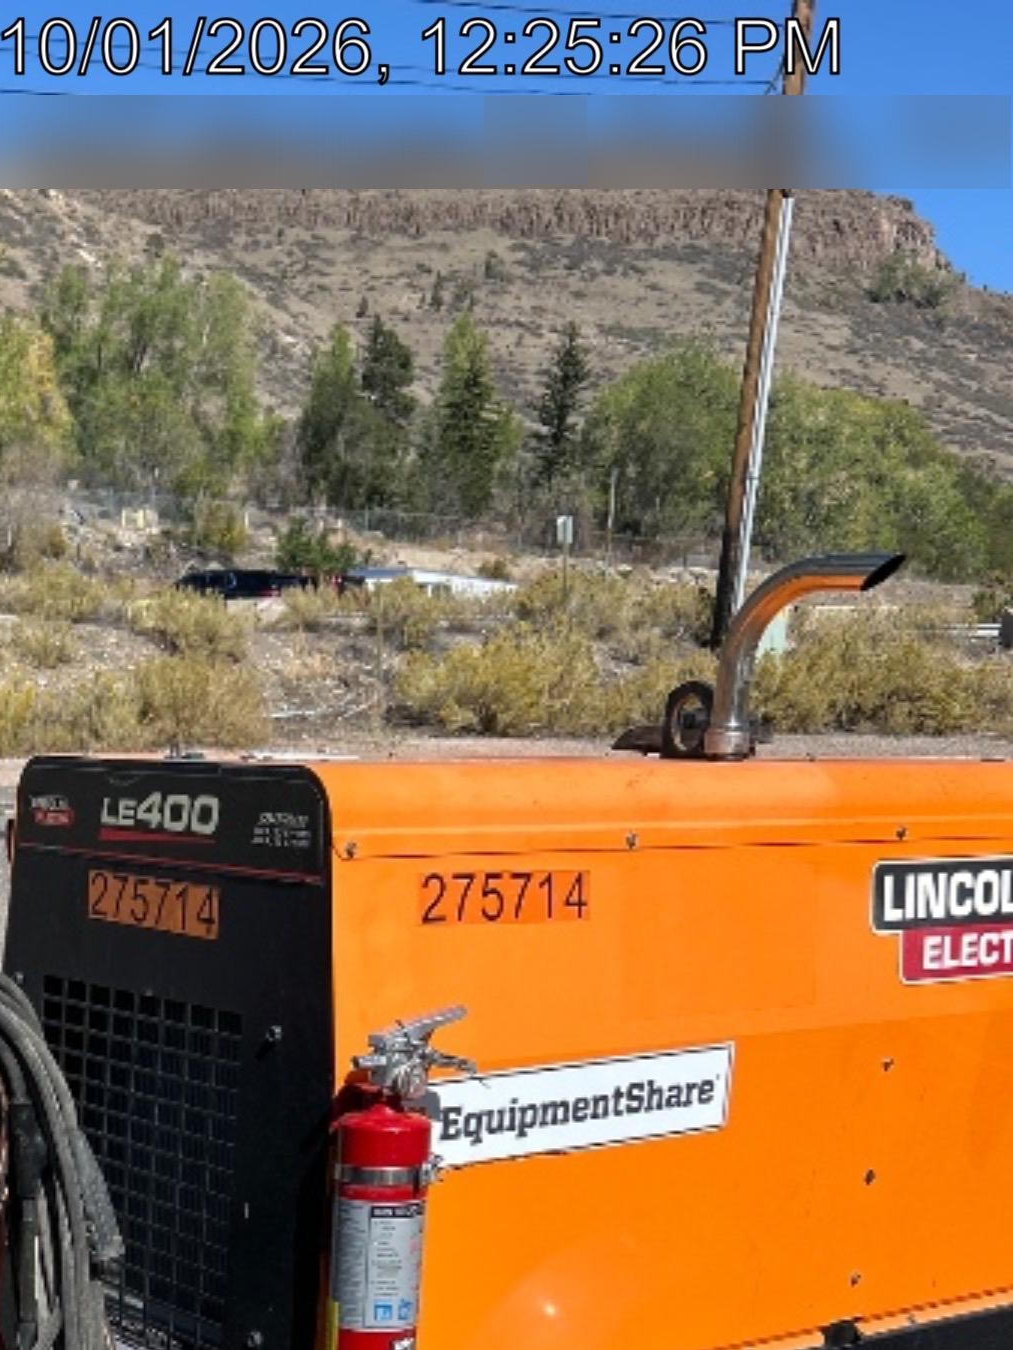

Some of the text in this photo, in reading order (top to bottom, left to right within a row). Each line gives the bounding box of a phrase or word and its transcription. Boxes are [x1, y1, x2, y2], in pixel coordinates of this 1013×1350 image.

[99, 791, 220, 835] LE400
[89, 871, 217, 934] 275714
[420, 871, 588, 924] 275714
[439, 1076, 715, 1146] EquipmentShare
